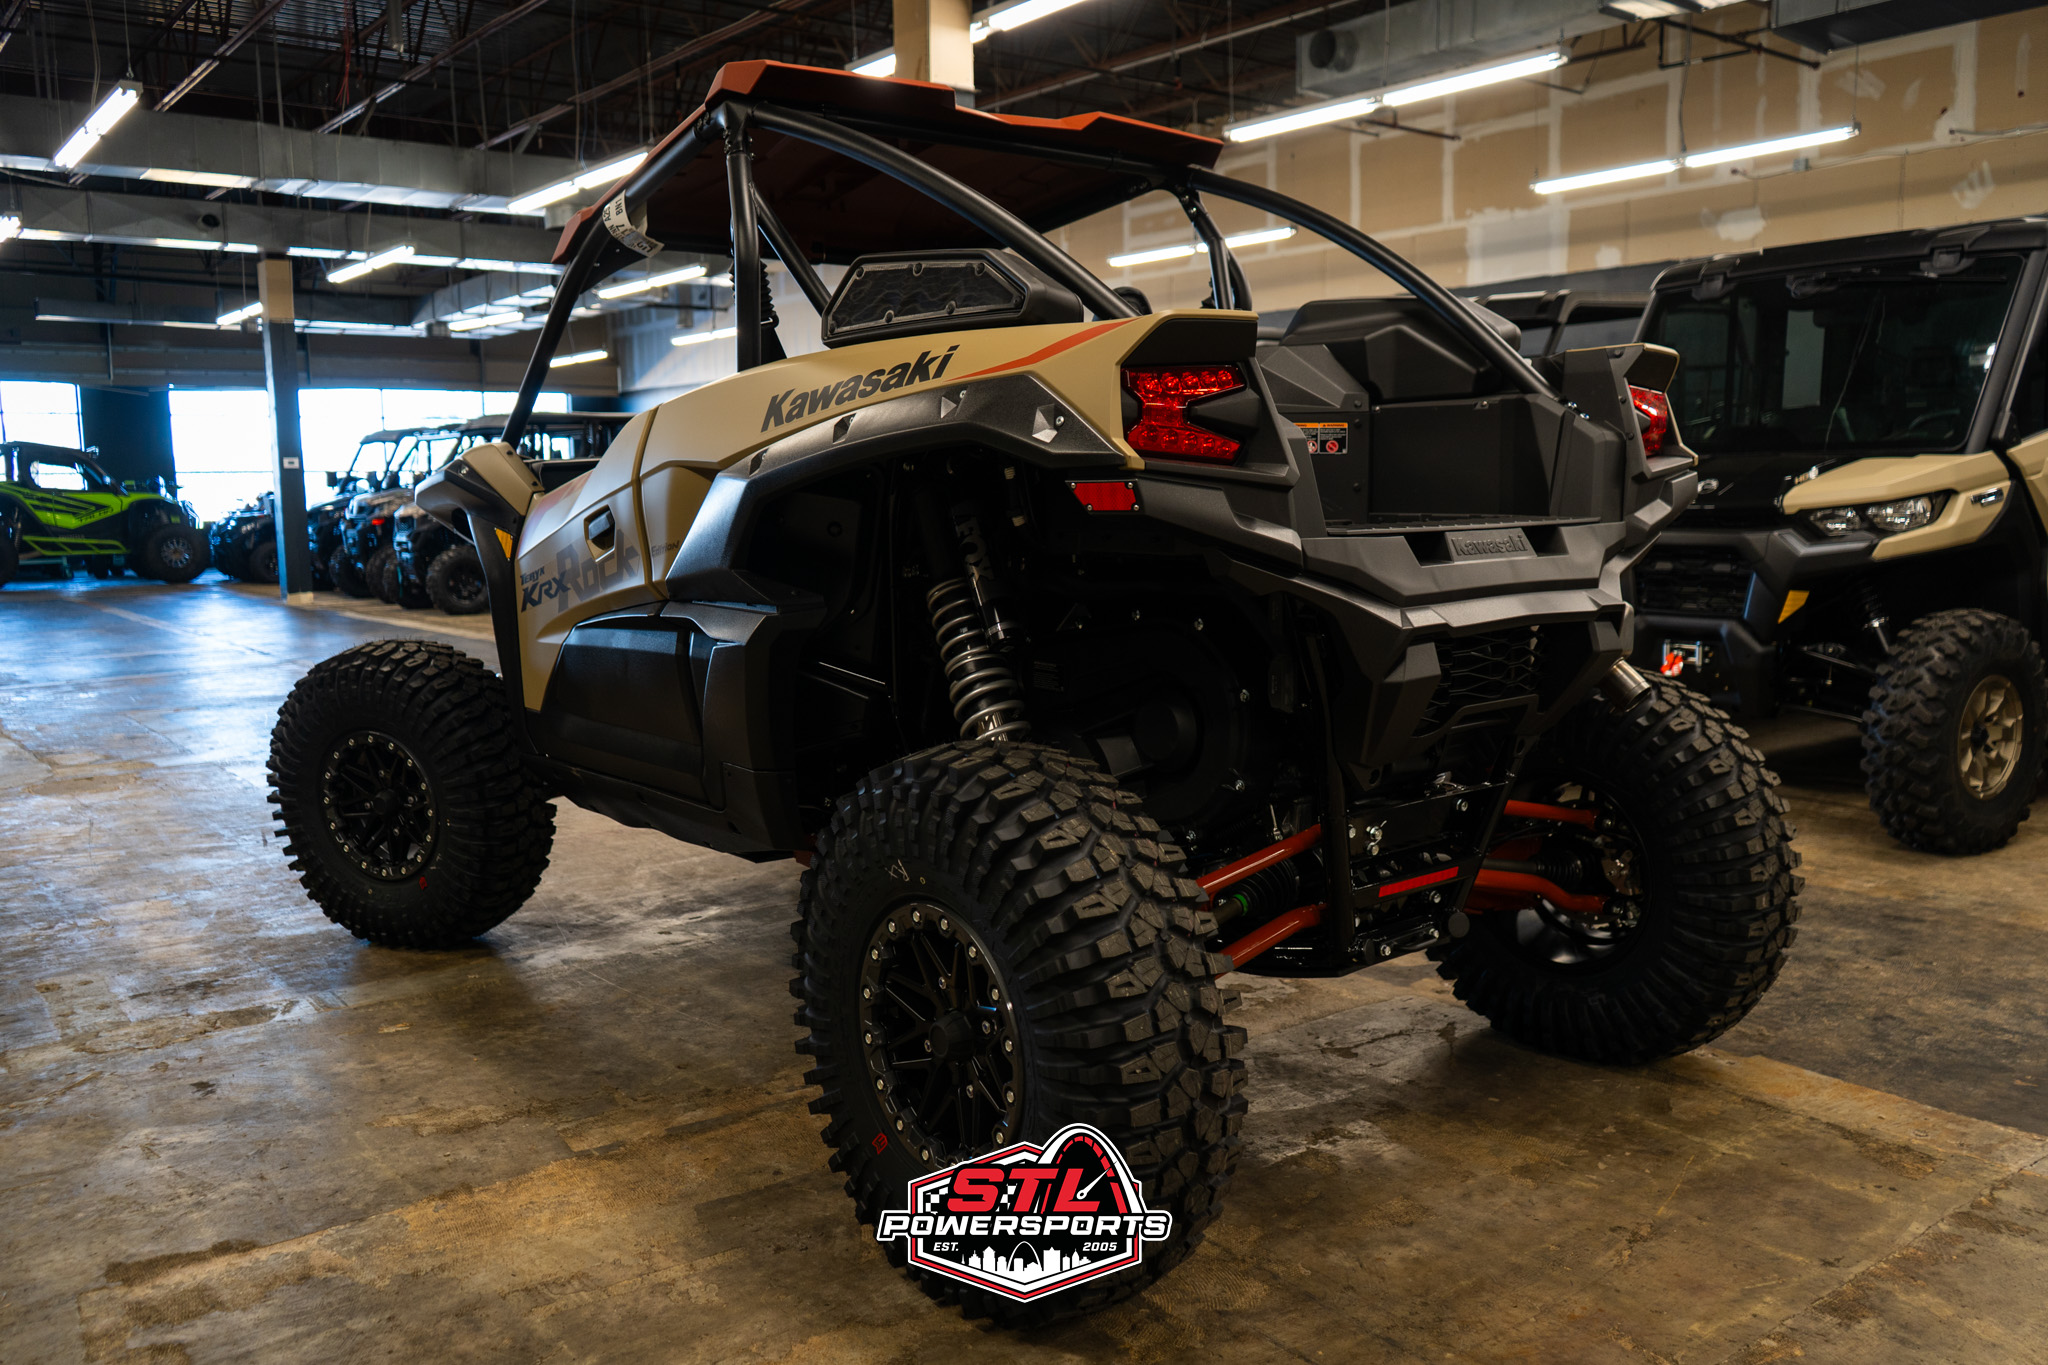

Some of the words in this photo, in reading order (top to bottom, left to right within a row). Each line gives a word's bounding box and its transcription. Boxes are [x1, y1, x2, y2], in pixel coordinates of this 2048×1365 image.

[760, 344, 961, 433] Kawasaki
[1450, 534, 1529, 556] Kawasaki
[521, 577, 571, 613] KRX
